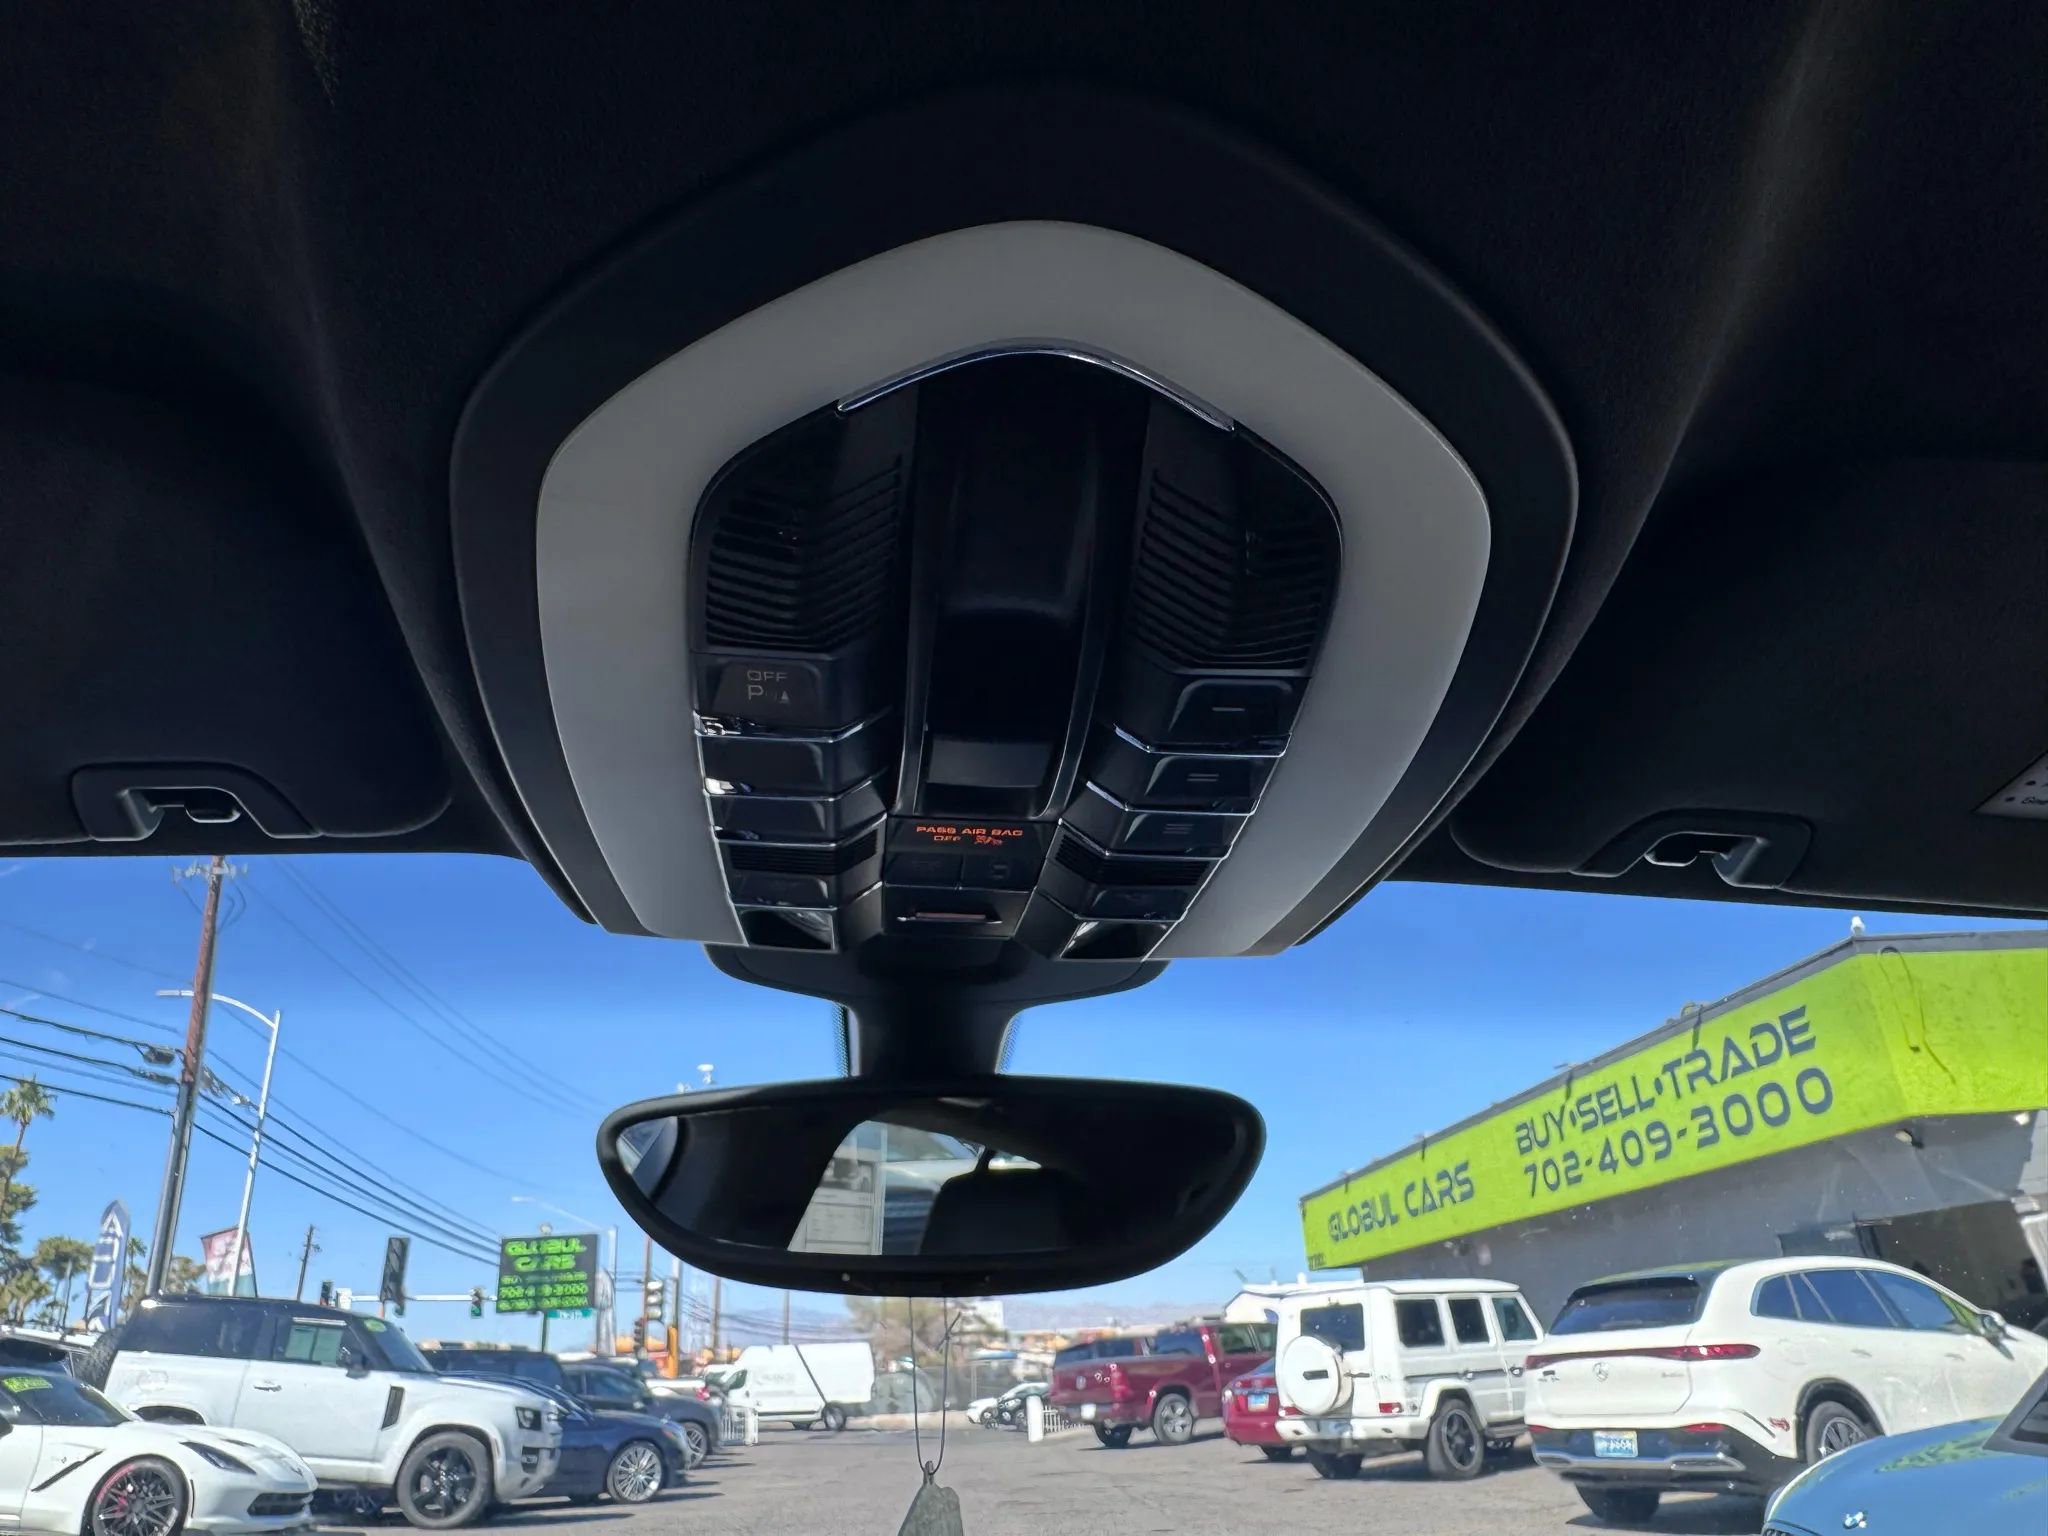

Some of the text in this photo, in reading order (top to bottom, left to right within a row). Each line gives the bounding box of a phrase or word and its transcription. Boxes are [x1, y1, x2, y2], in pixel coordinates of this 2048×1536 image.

[746, 669, 788, 682] OFF
[916, 825, 1024, 837] PASS AIR BAG
[1523, 1067, 1834, 1199] 702-409-3000
[1327, 1159, 1475, 1243] GLOBUL CARS
